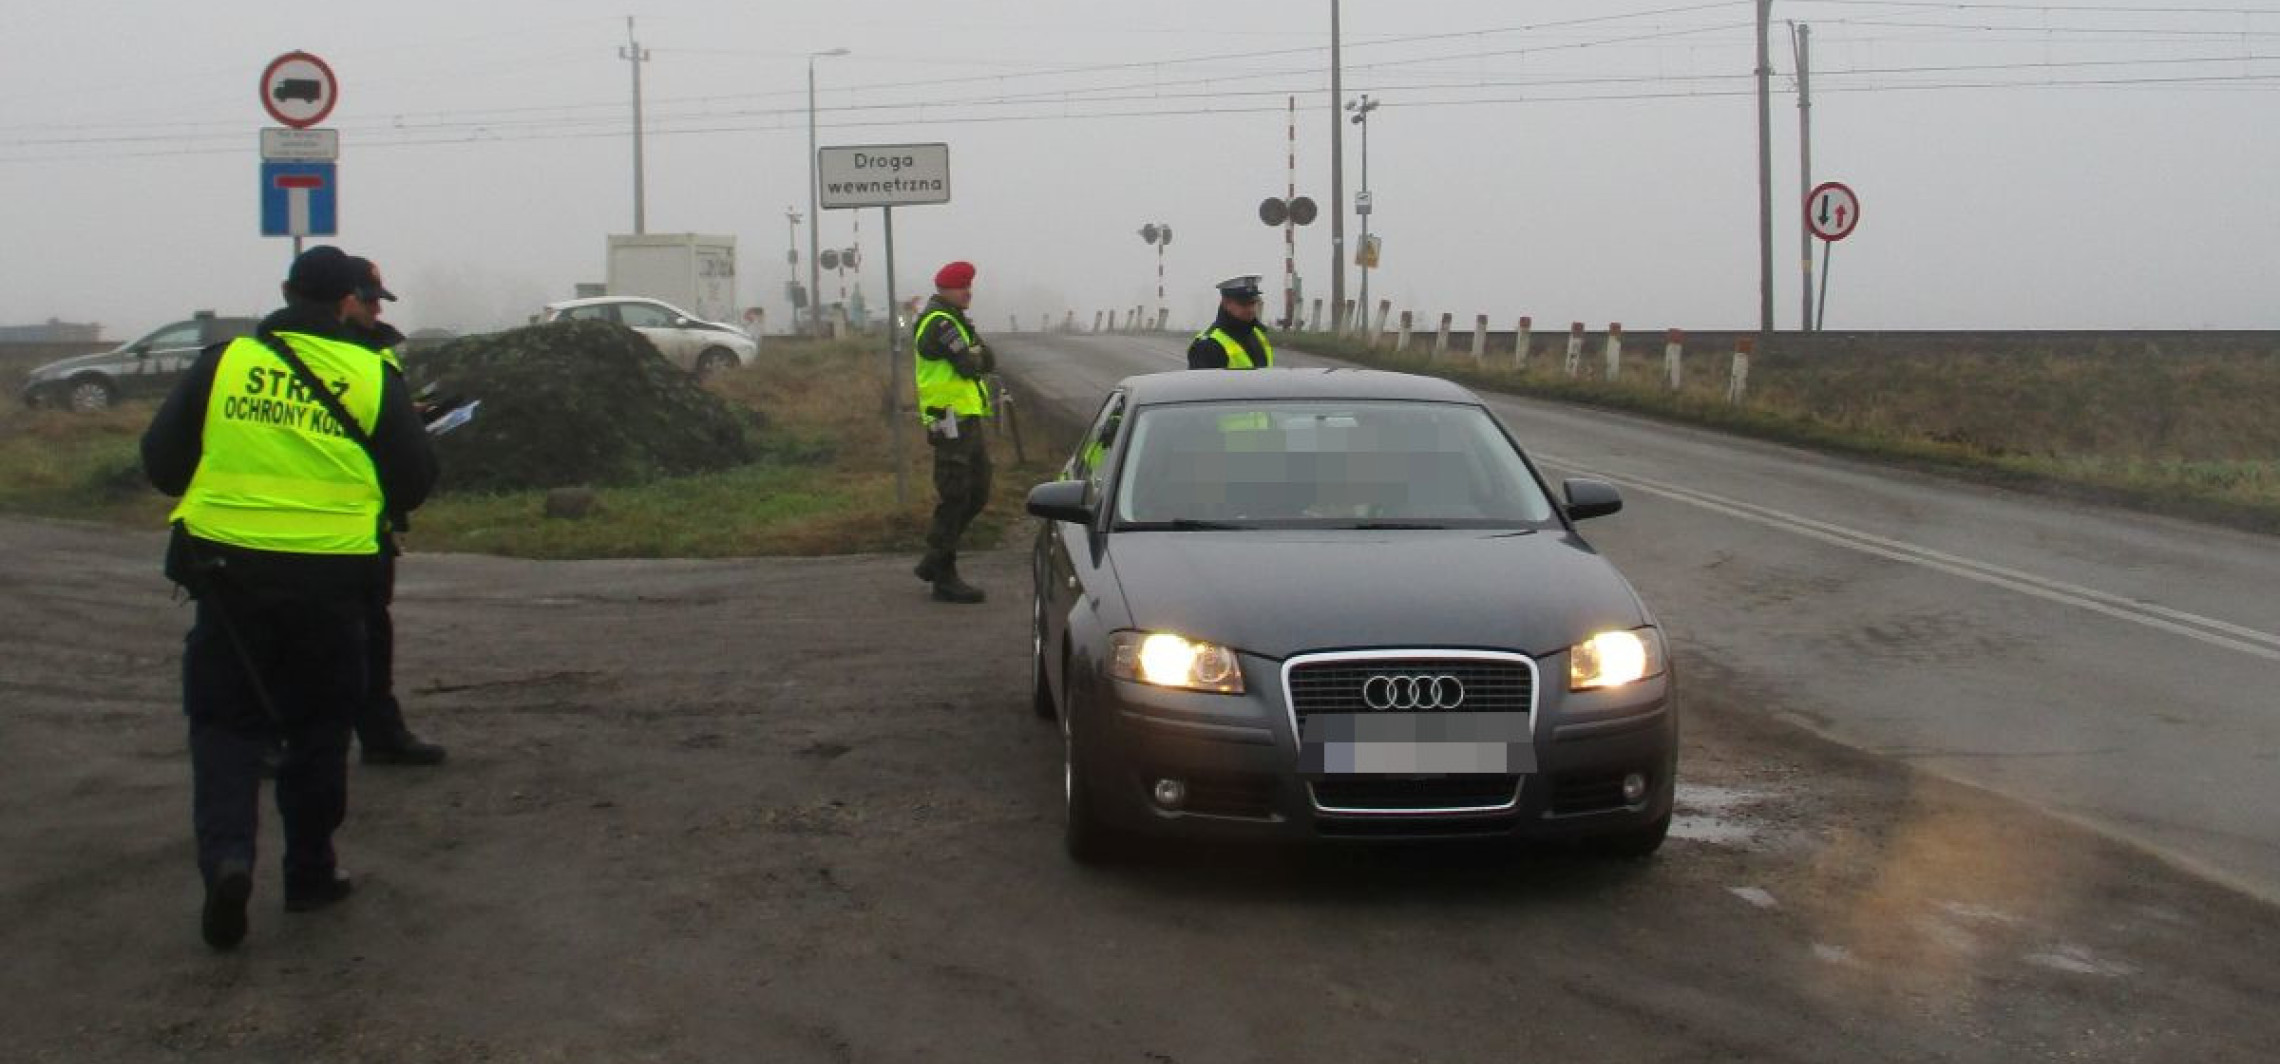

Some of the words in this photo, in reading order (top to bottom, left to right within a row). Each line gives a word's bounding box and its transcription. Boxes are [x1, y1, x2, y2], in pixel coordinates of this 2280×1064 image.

[854, 153, 913, 172] Droga
[827, 178, 942, 196] wewnętrzna
[246, 366, 350, 404] STRŻ
[224, 396, 308, 428] OCHRONY
